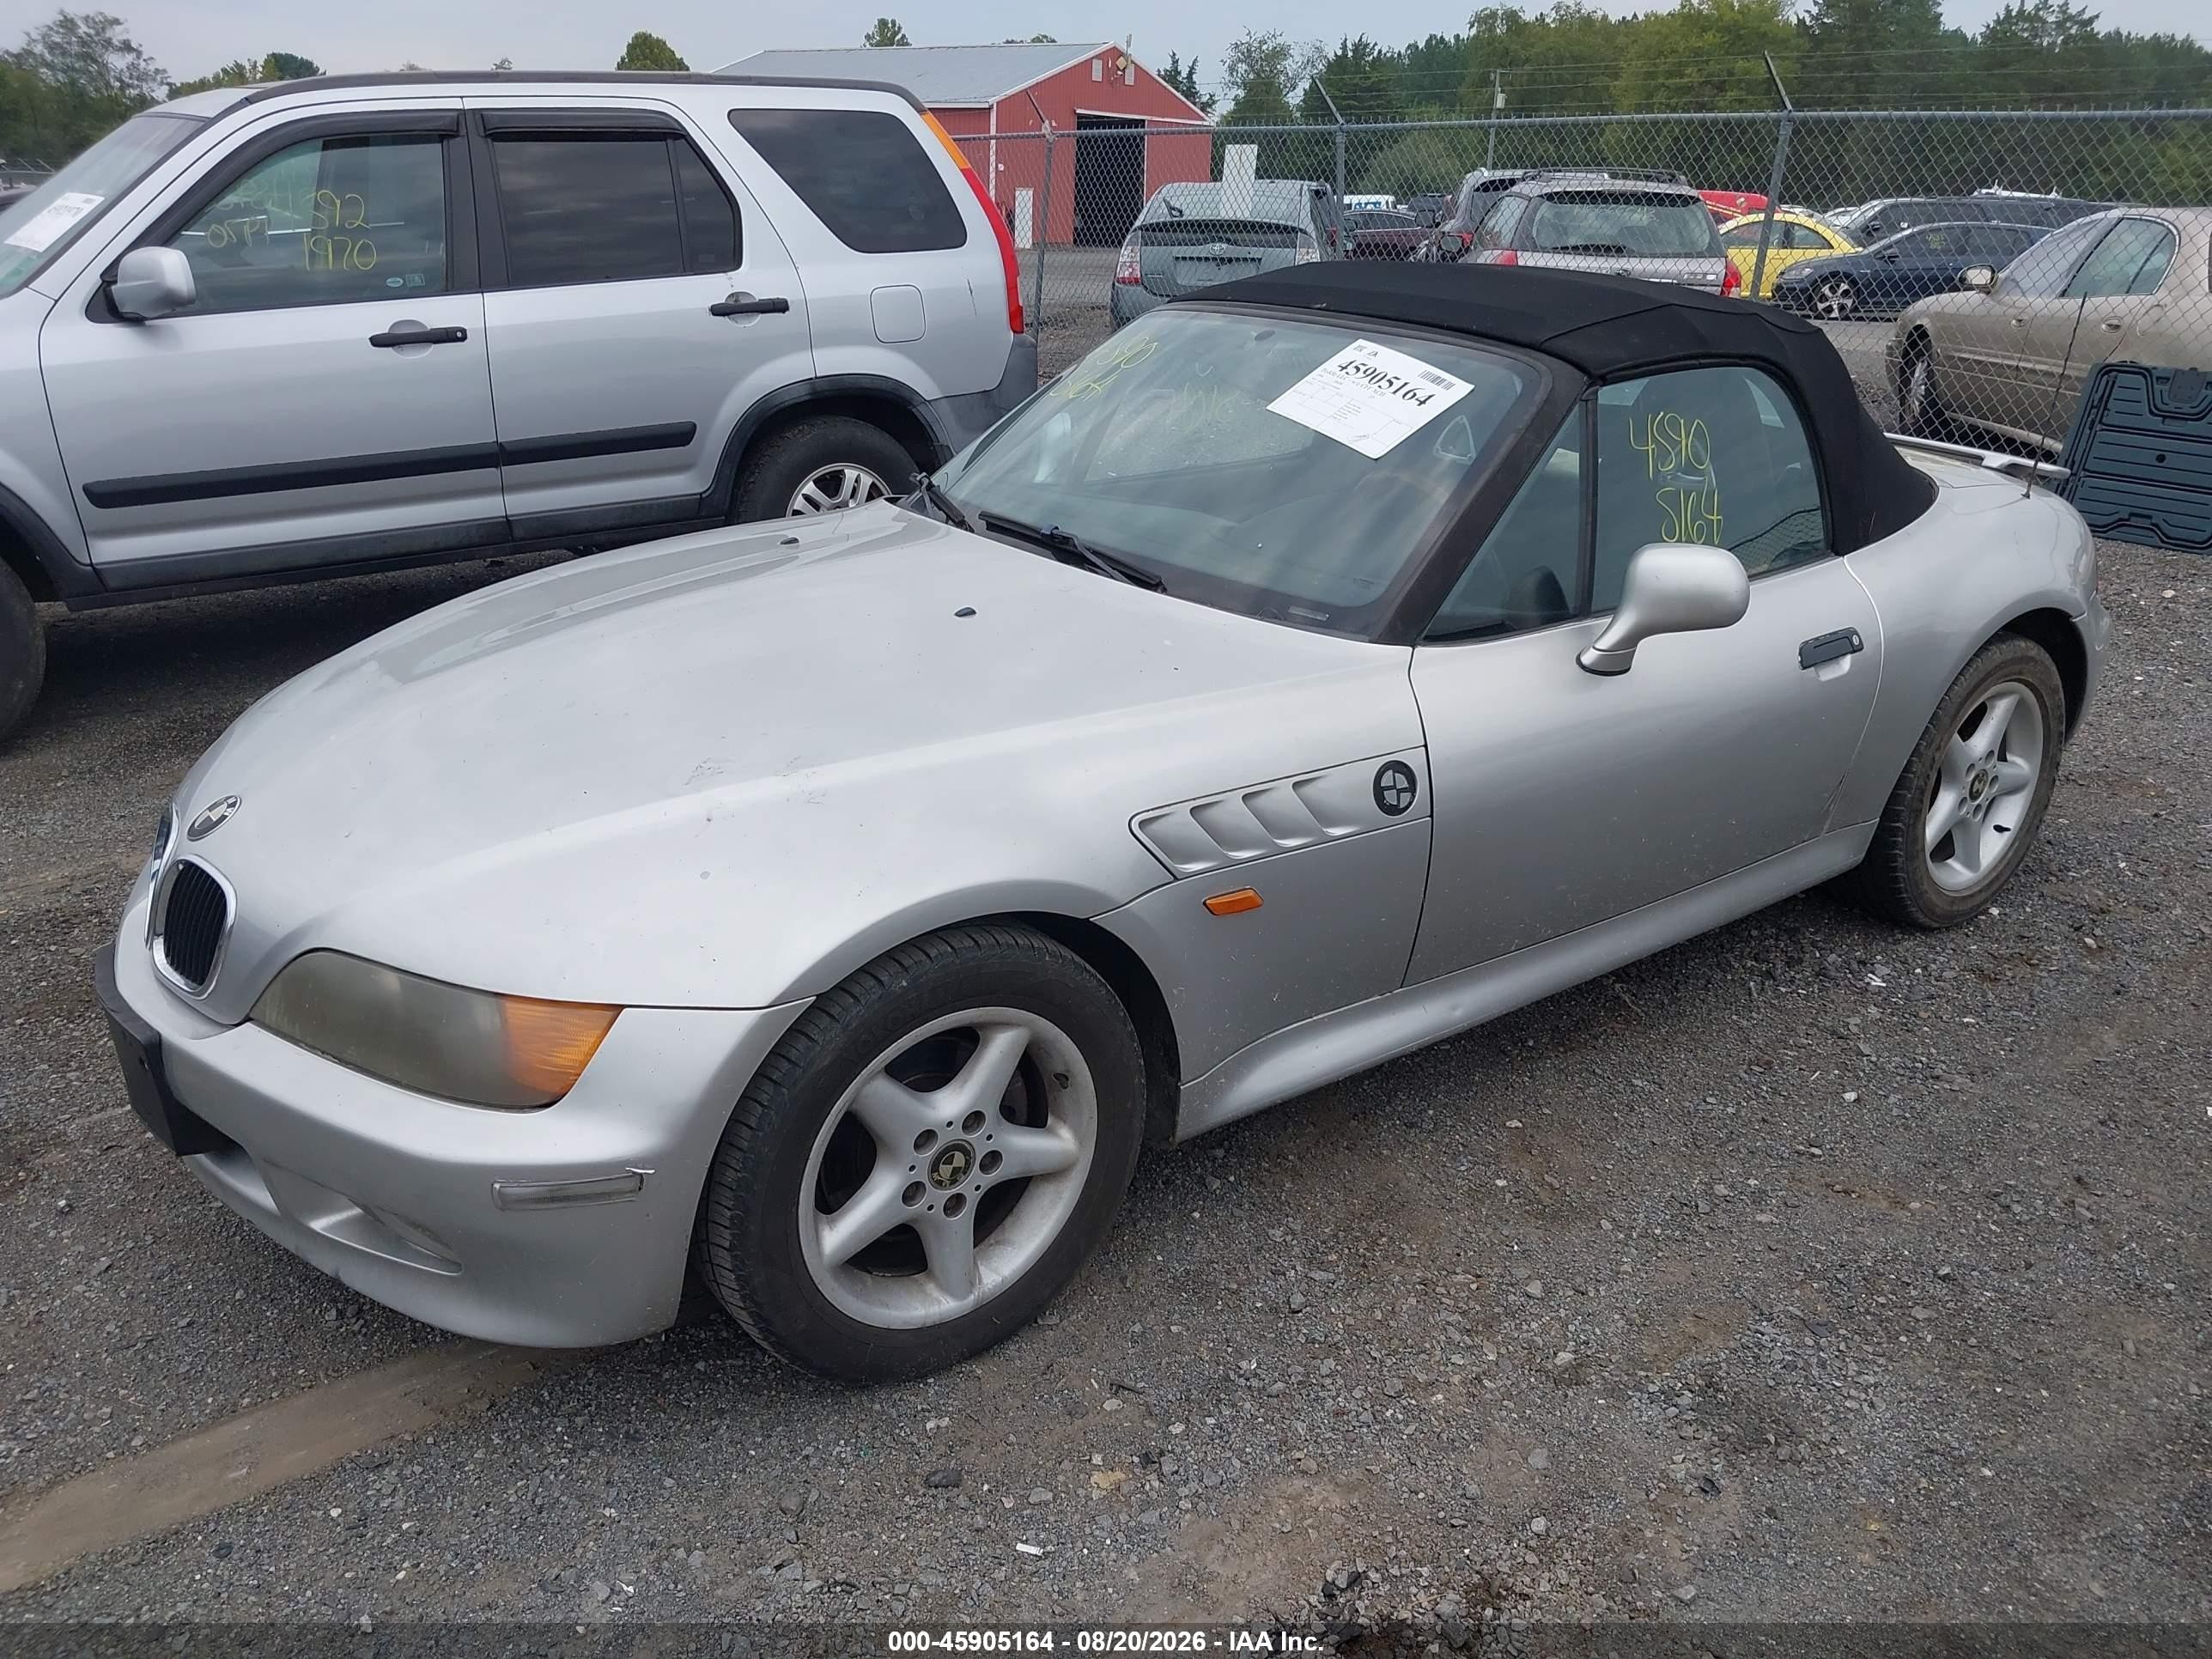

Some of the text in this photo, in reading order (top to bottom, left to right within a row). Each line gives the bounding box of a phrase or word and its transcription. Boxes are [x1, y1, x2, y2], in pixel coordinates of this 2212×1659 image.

[303, 234, 377, 271] 1970
[1336, 359, 1437, 407] 45905164
[1628, 411, 1711, 481] 4590
[1655, 477, 1723, 544] 5164
